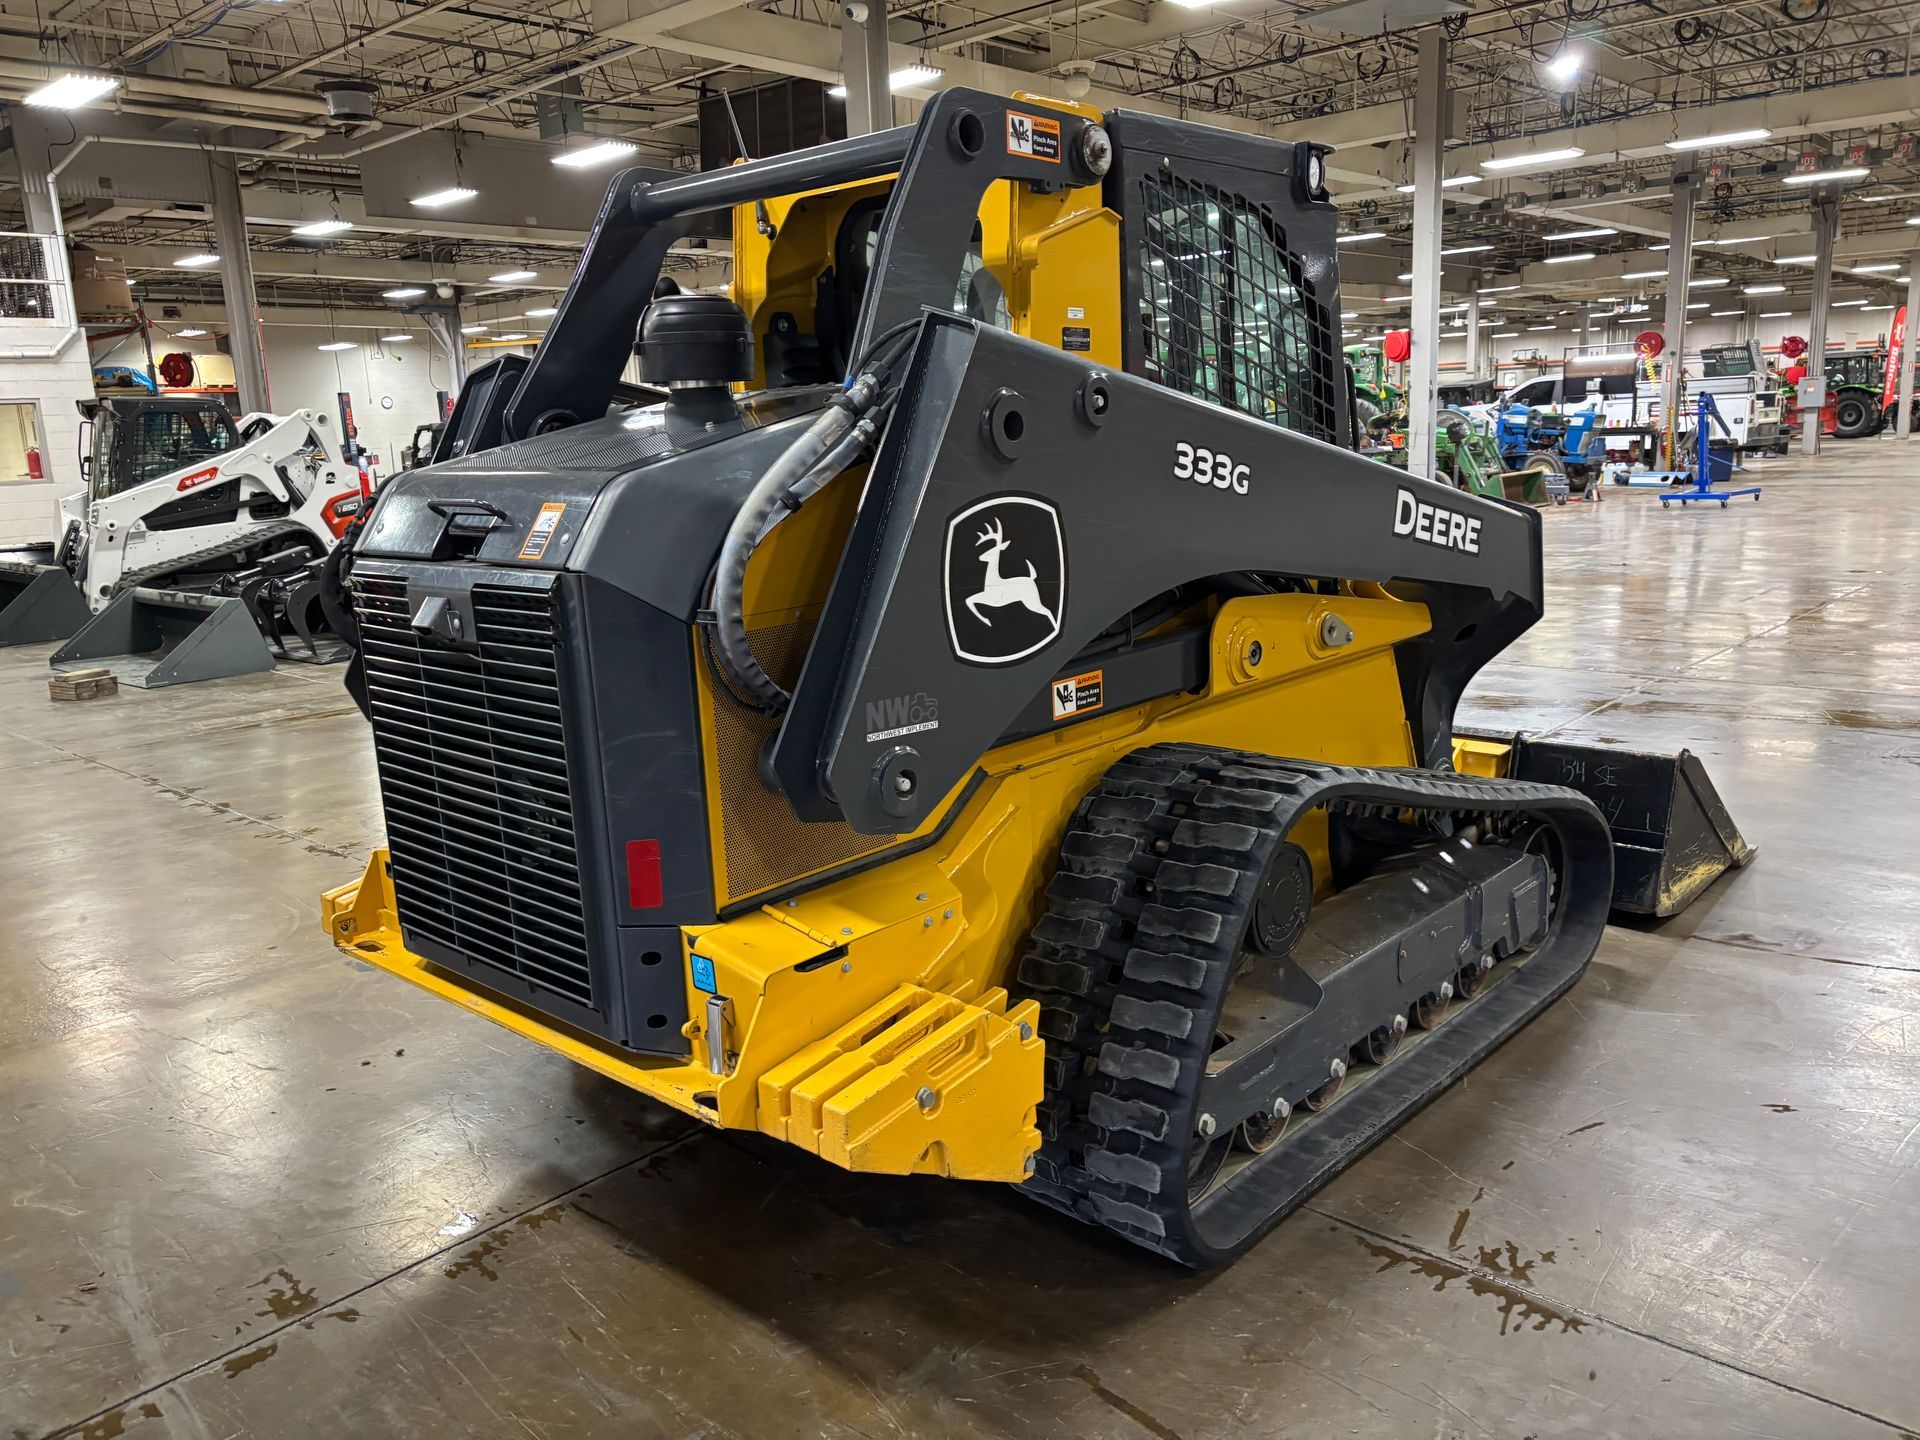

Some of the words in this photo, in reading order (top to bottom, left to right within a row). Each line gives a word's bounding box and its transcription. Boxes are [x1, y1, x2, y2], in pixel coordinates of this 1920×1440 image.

[1033, 135, 1046, 144] Pinch
[1047, 138, 1057, 146] Area
[1898, 142, 1913, 153] 107
[1801, 157, 1815, 166] 103
[1849, 151, 1865, 161] 105
[1625, 181, 1636, 190] 95
[1174, 442, 1251, 495] 333G
[1393, 488, 1482, 554] DEERE
[1077, 689, 1090, 698] Pinch
[1090, 687, 1100, 695] Area
[866, 695, 909, 732] NW
[867, 729, 904, 742] NORTHWEST
[905, 721, 938, 733] IMPLEMENT
